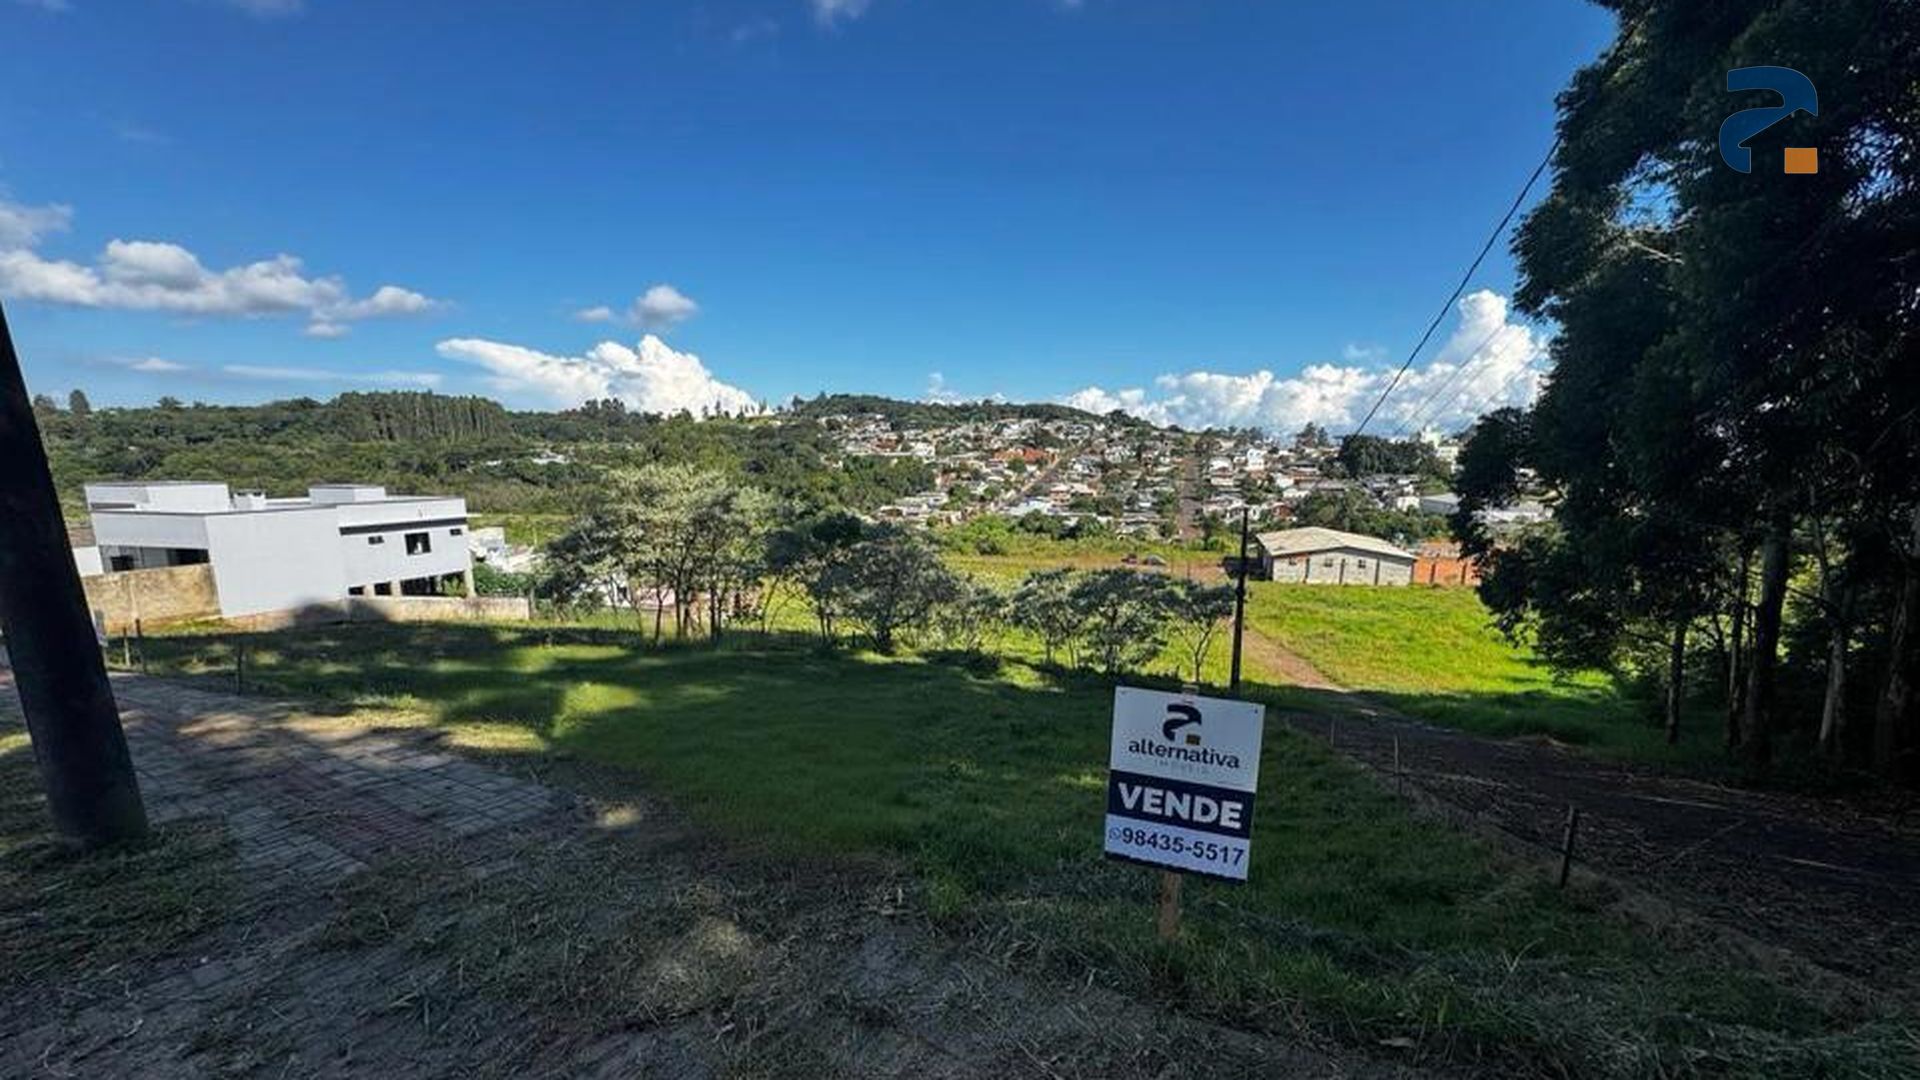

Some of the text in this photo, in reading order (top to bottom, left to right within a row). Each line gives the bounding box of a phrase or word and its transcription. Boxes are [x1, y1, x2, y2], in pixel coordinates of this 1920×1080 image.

[1128, 738, 1240, 769] alternativa
[1118, 782, 1244, 829] VENDE
[1122, 827, 1244, 866] 98435-5517
